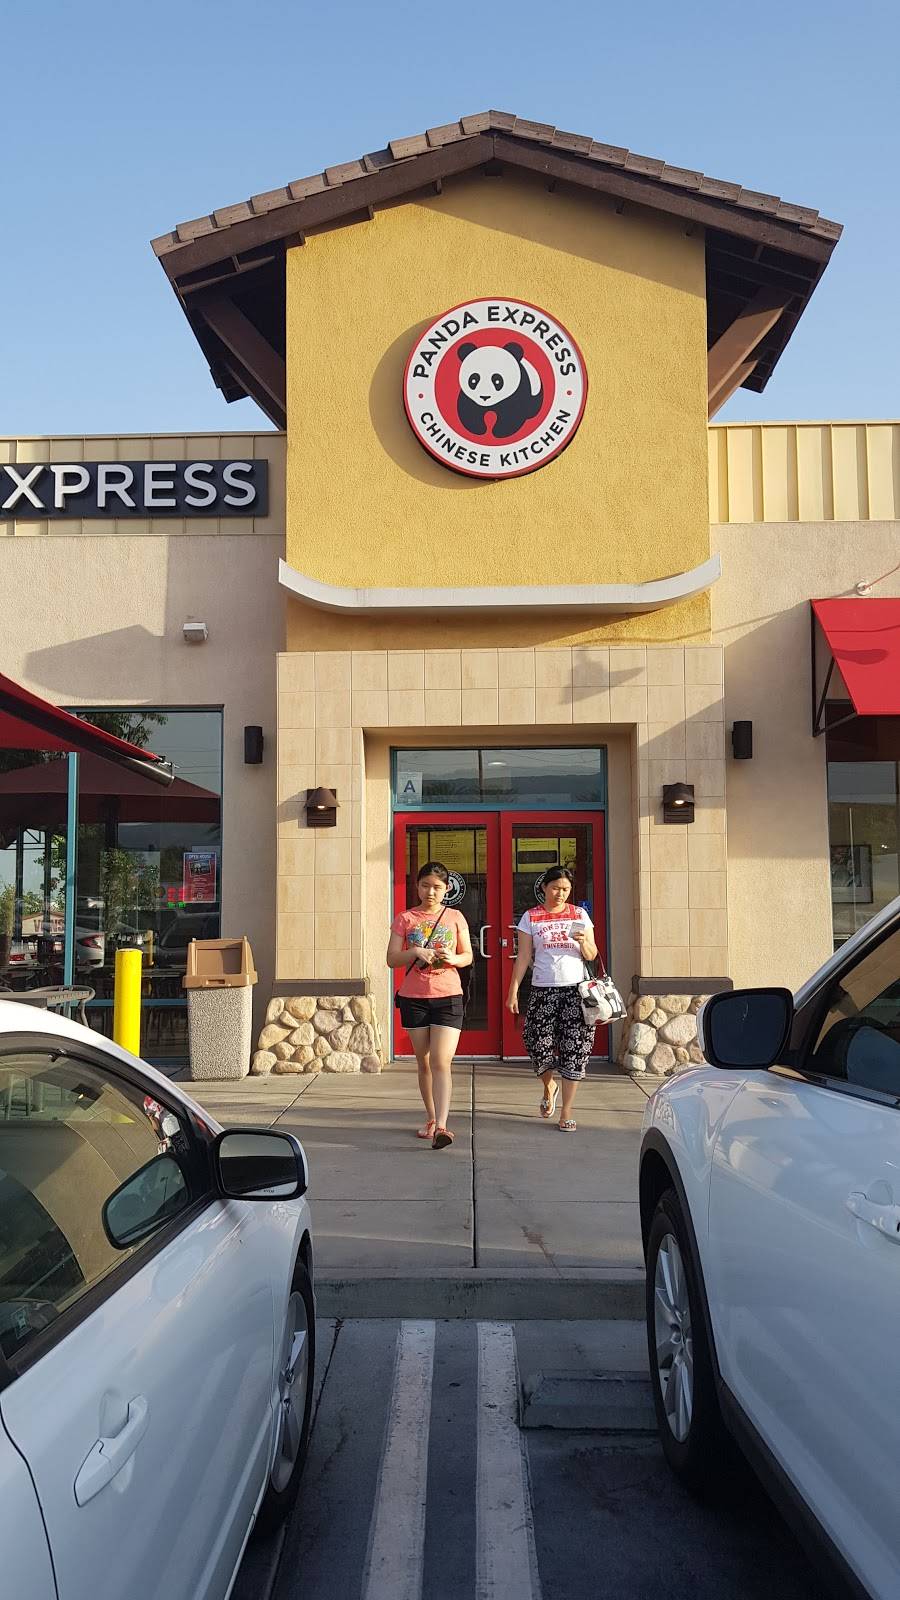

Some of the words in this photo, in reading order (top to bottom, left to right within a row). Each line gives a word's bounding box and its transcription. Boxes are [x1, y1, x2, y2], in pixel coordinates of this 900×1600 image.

[412, 310, 479, 379] PANDA
[487, 305, 577, 377] EXPRESS
[420, 411, 491, 467] CHINESE
[499, 409, 571, 467] KITCHEN
[1, 462, 256, 509] XPRESS
[403, 779, 416, 793] A
